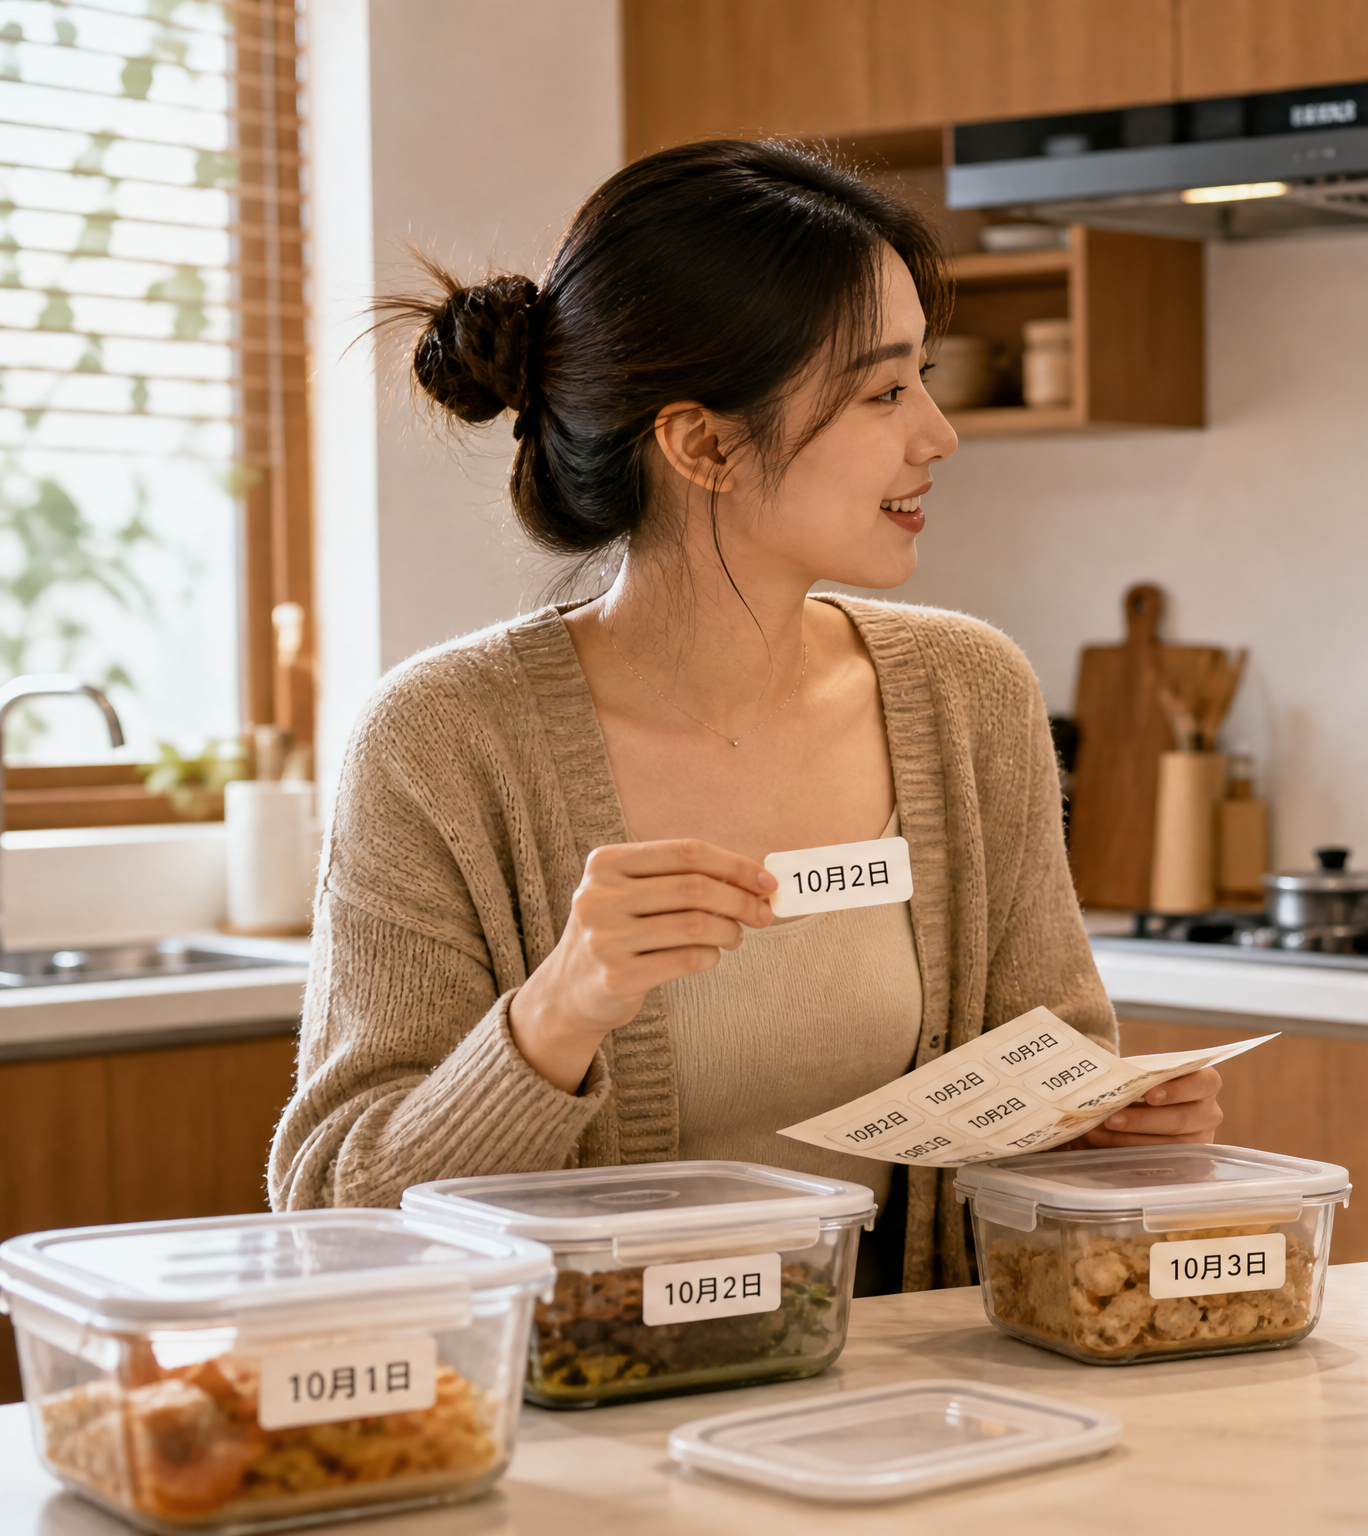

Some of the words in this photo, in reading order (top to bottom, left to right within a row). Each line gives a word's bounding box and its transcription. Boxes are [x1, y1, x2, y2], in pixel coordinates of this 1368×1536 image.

[793, 860, 889, 894] 10月2日
[1000, 1033, 1059, 1066] 10月2日
[925, 1072, 985, 1105] 10月2日
[1041, 1059, 1098, 1091] 10月2日
[845, 1111, 908, 1143] 10月2日
[967, 1097, 1027, 1129] 10月2日
[1170, 1251, 1266, 1281] 10月3日
[665, 1273, 761, 1305] 10月2日
[290, 1360, 410, 1402] 10月1日
